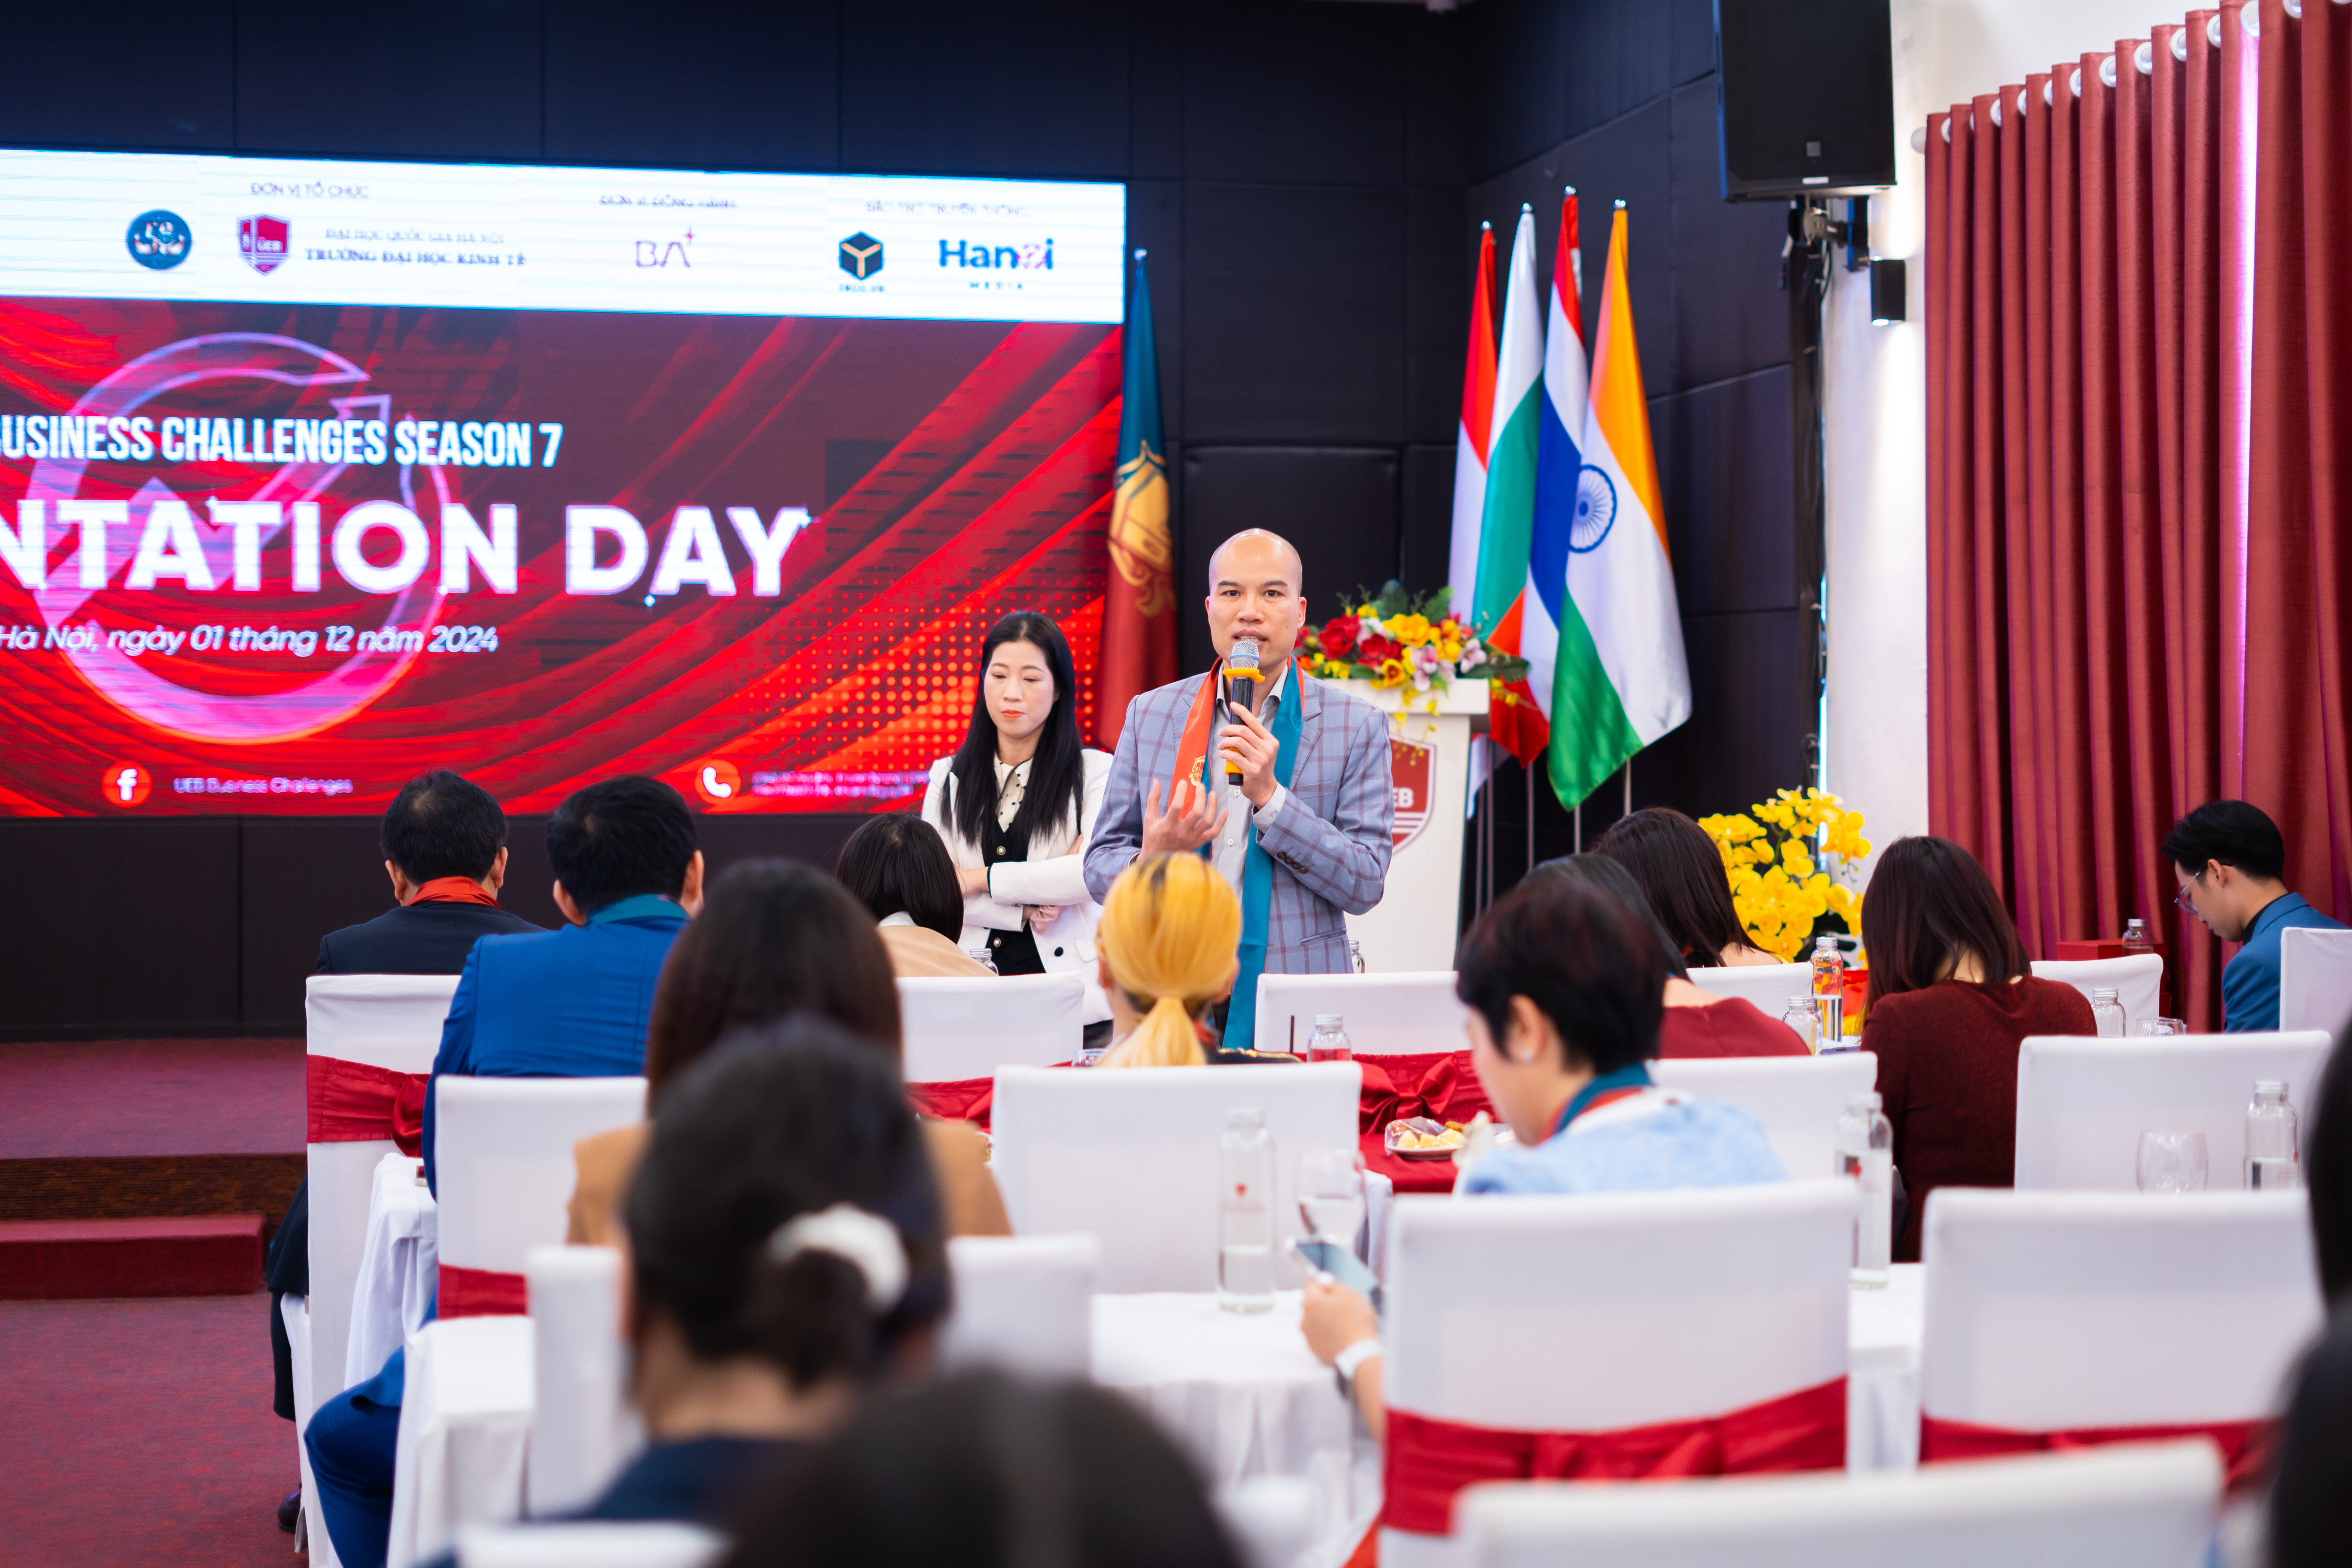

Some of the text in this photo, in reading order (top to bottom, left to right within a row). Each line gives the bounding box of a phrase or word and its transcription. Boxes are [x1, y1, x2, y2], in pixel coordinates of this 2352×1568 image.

[304, 245, 377, 262] TRƯỜNG
[382, 250, 412, 265] ĐẠI
[416, 251, 453, 266] HỌC
[457, 253, 501, 266] KINH
[0, 414, 564, 467] USINESS CHALLENGES SEASON 7
[0, 499, 810, 597] NTATION DAY
[0, 624, 500, 657] Hà Nội, ngày 01 tháng 12 năm 2024
